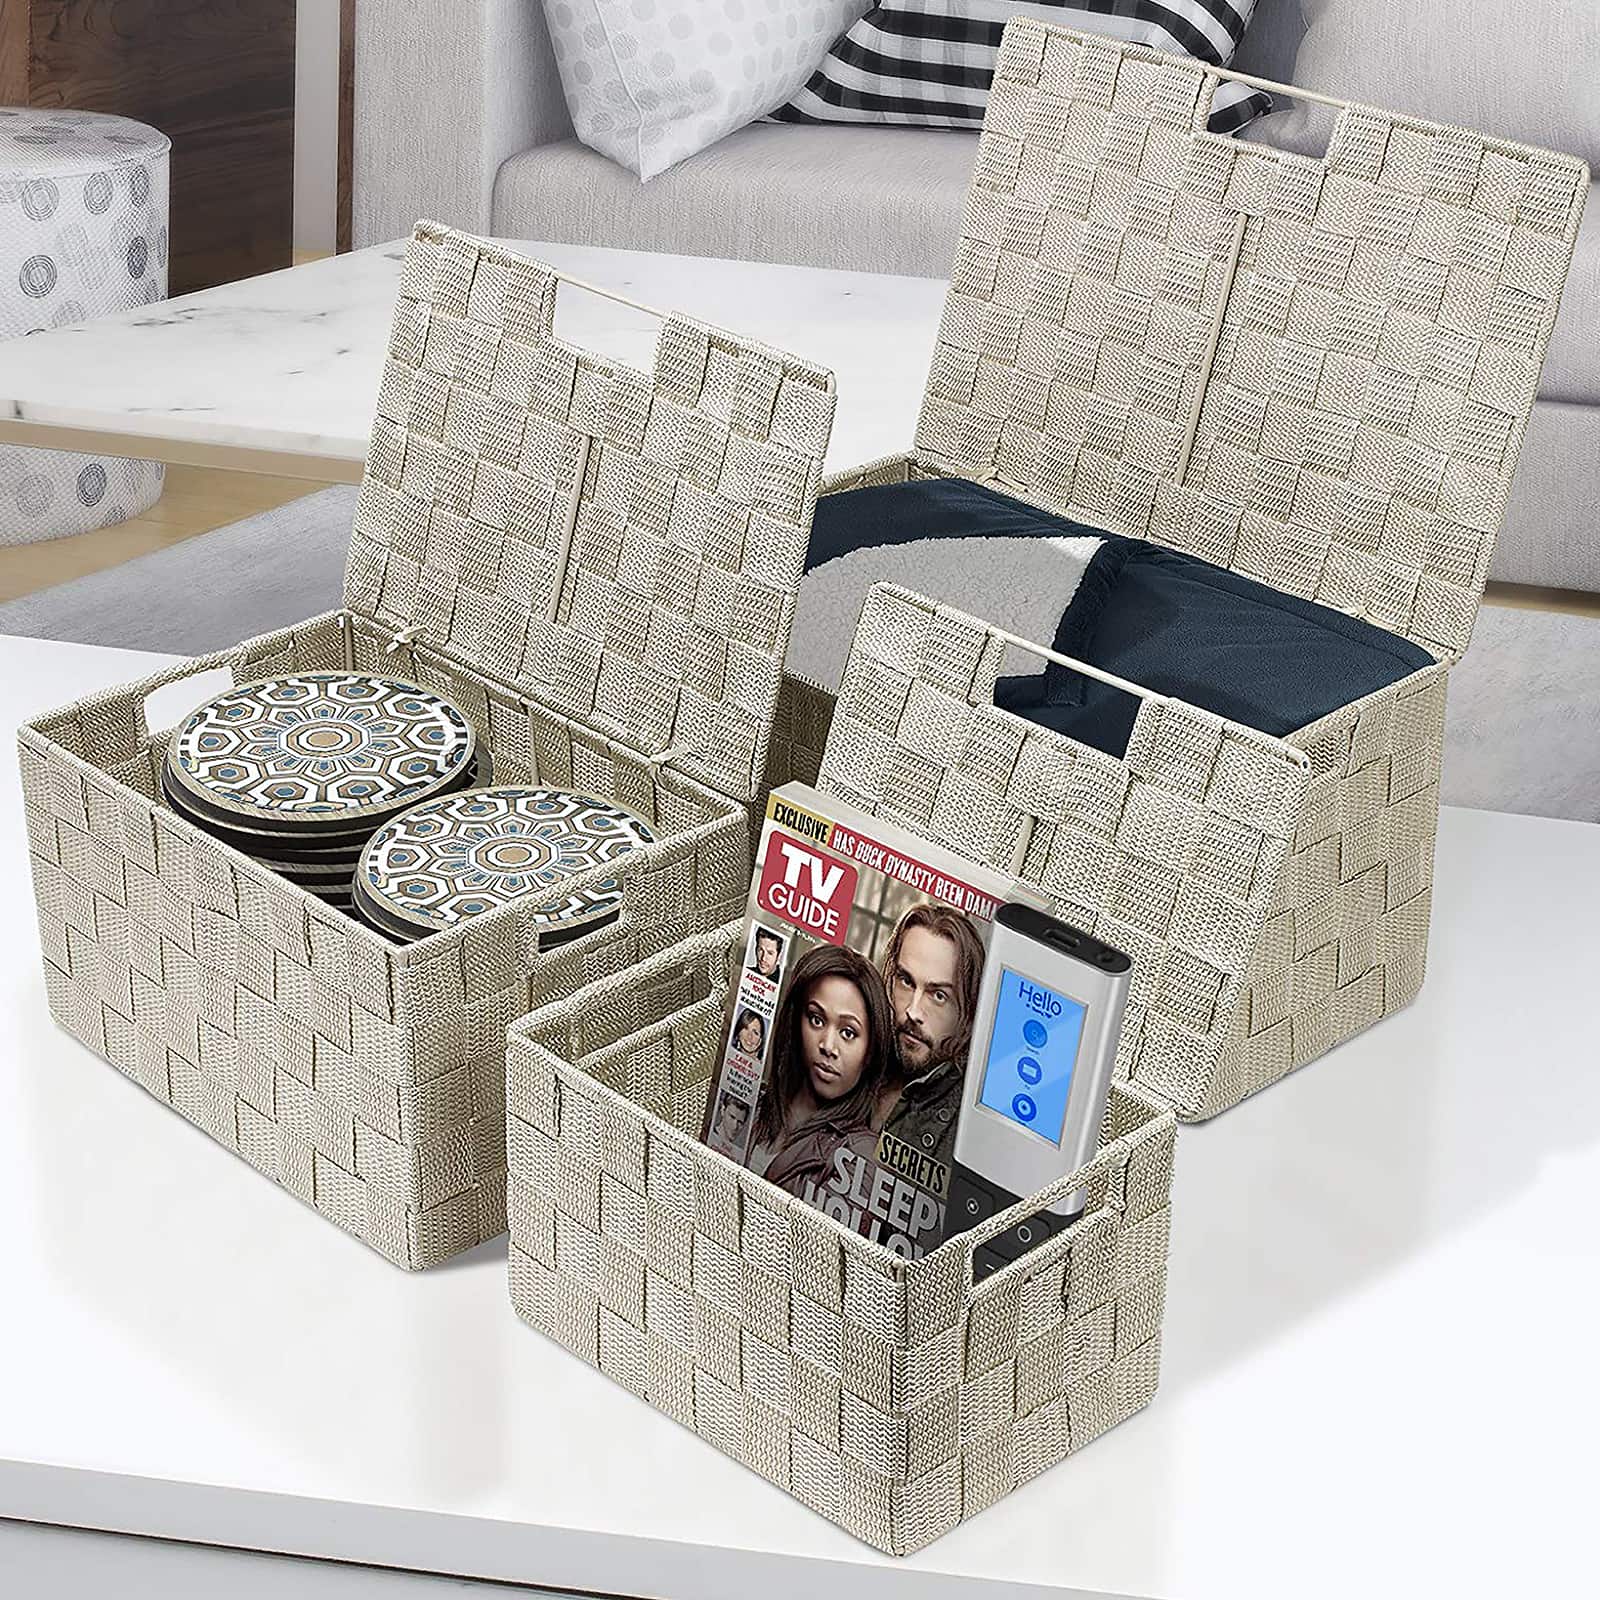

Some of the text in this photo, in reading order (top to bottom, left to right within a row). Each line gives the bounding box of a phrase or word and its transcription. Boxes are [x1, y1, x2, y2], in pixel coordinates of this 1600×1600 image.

[773, 802, 829, 844] EXCLUSIVE
[781, 841, 846, 904] TV
[833, 829, 855, 856] HAS
[855, 840, 886, 871] DUCK
[884, 854, 936, 893] DYNASTY
[935, 876, 965, 907] BEEN
[768, 882, 840, 937] GUIDE
[1019, 981, 1062, 1016] Hello
[879, 1134, 946, 1194] SECRETS
